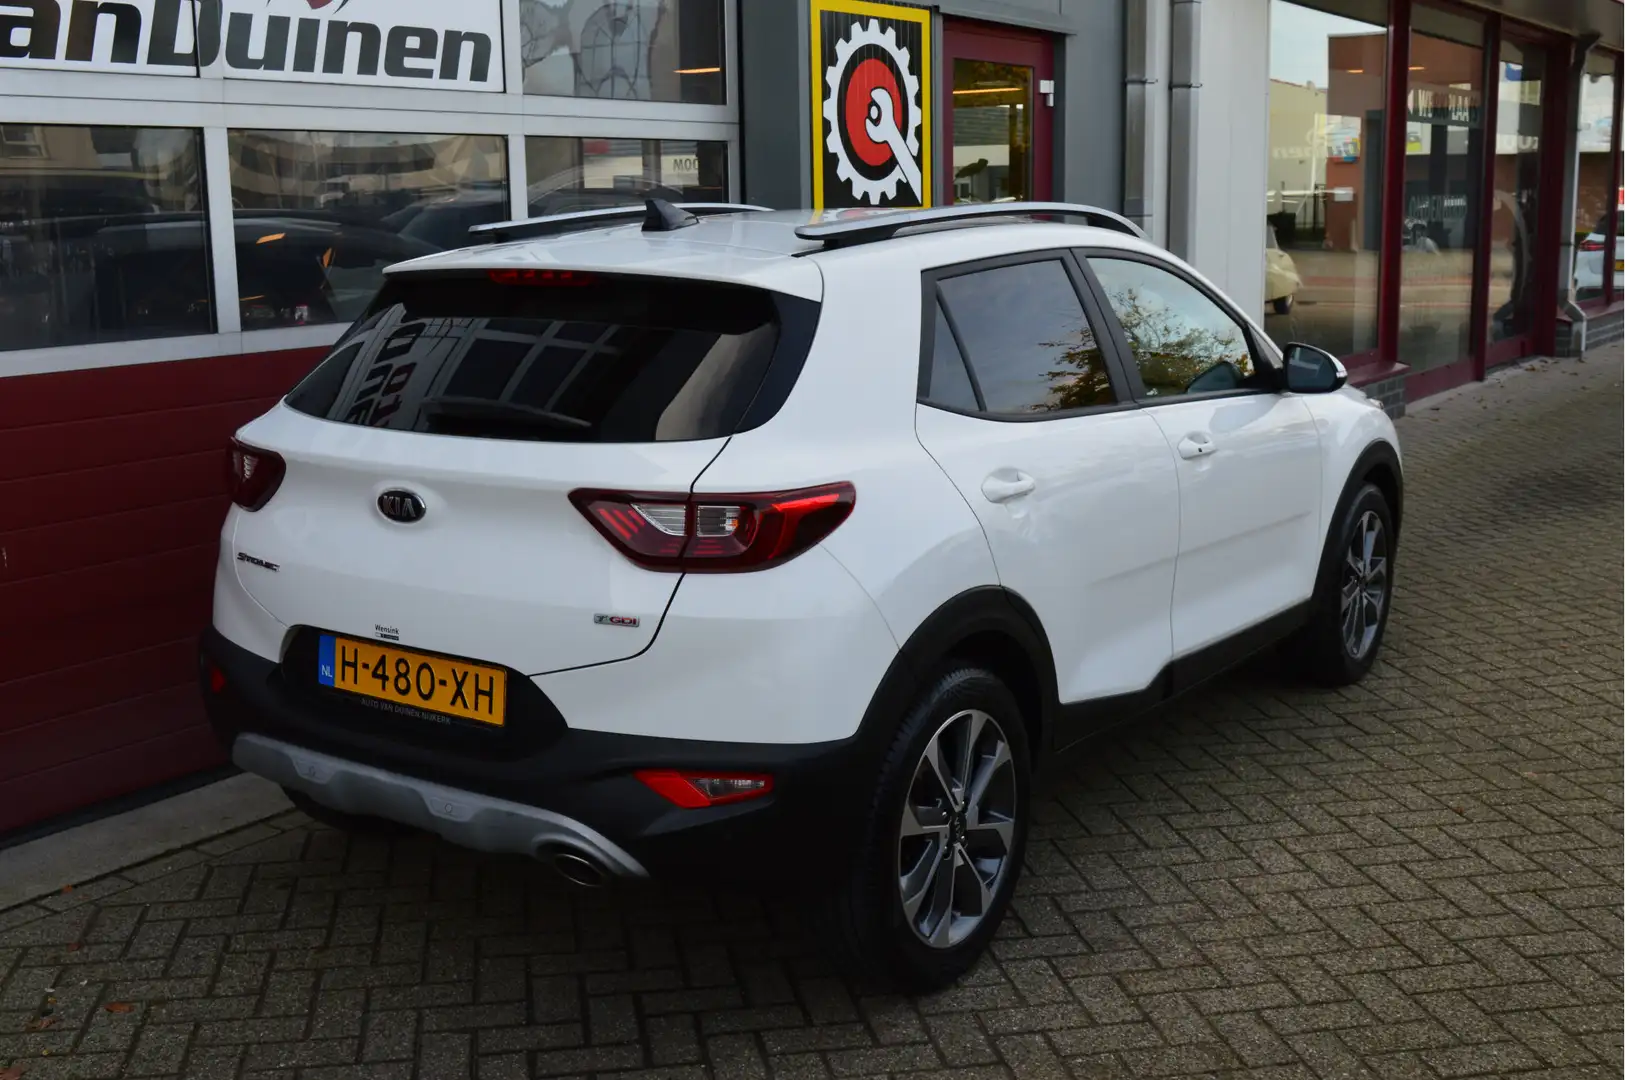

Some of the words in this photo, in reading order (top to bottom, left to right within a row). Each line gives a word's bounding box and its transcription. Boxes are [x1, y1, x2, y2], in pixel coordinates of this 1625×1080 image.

[382, 495, 416, 517] KIA
[374, 624, 400, 635] Wensink
[321, 664, 333, 678] NL
[340, 645, 495, 715] H-480-XH
